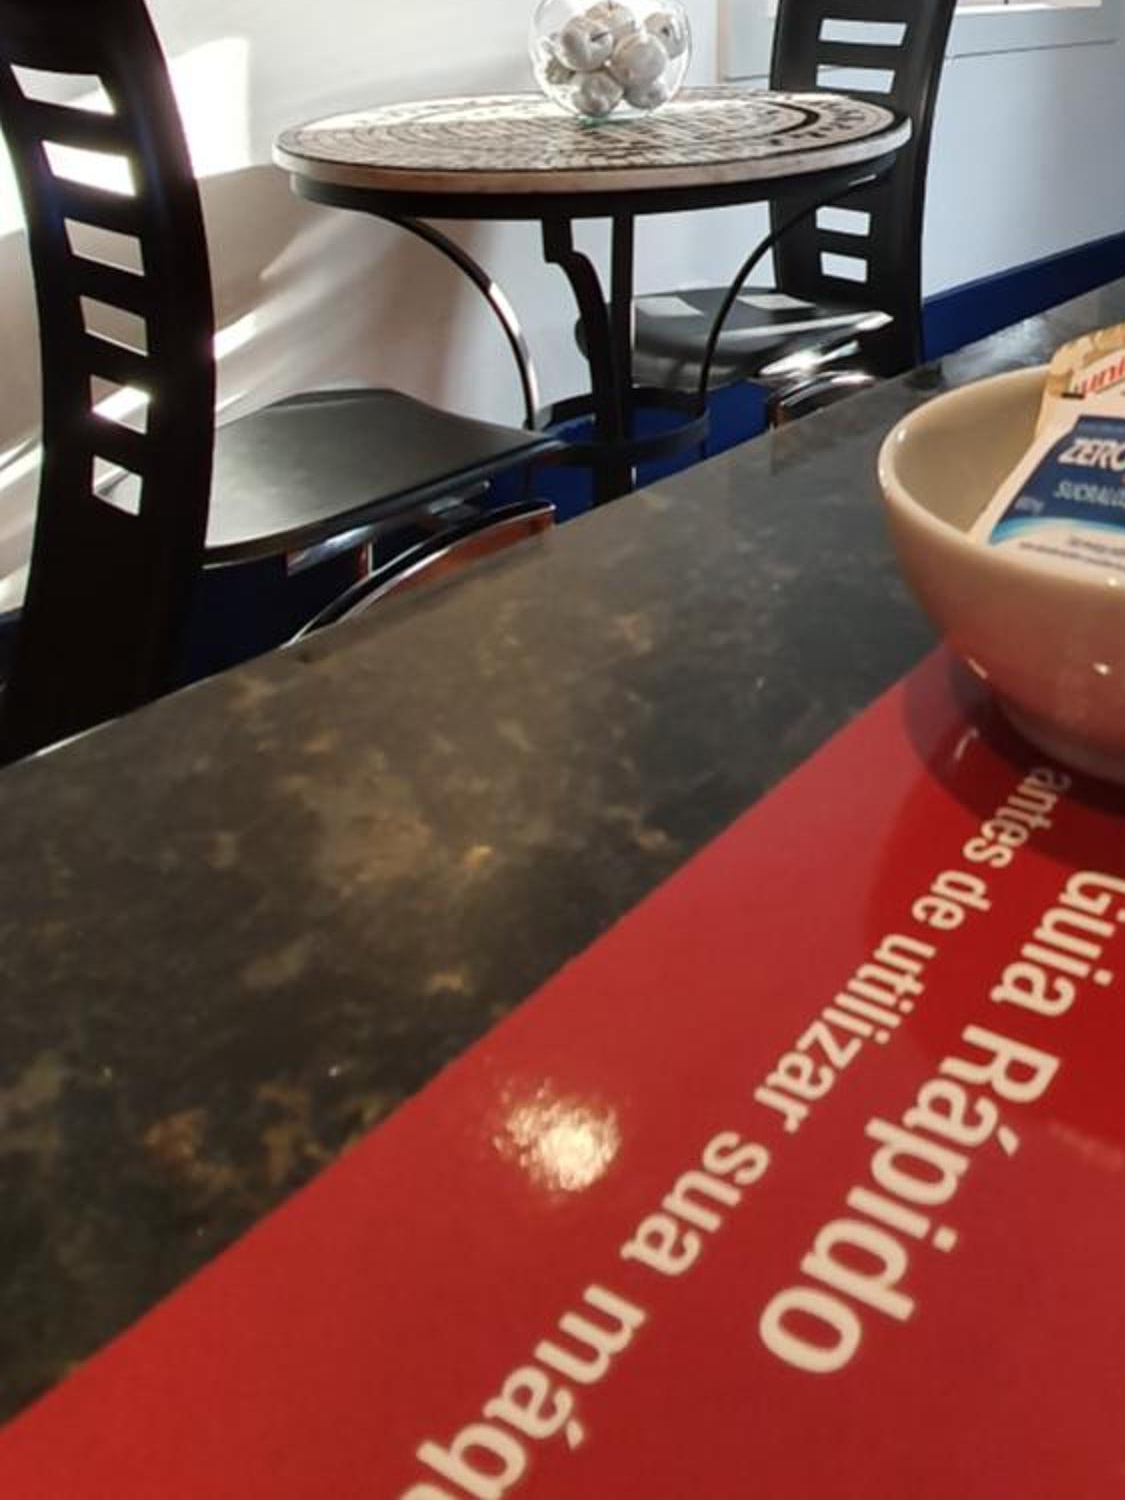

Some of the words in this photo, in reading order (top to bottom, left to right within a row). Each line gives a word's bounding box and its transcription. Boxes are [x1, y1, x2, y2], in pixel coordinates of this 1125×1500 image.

[911, 870, 992, 931] de
[963, 767, 1071, 868] antes
[753, 933, 937, 1133] utilizar
[620, 1131, 771, 1278] sua
[757, 1023, 1062, 1375] Rápido
[400, 1283, 647, 1500] máq
